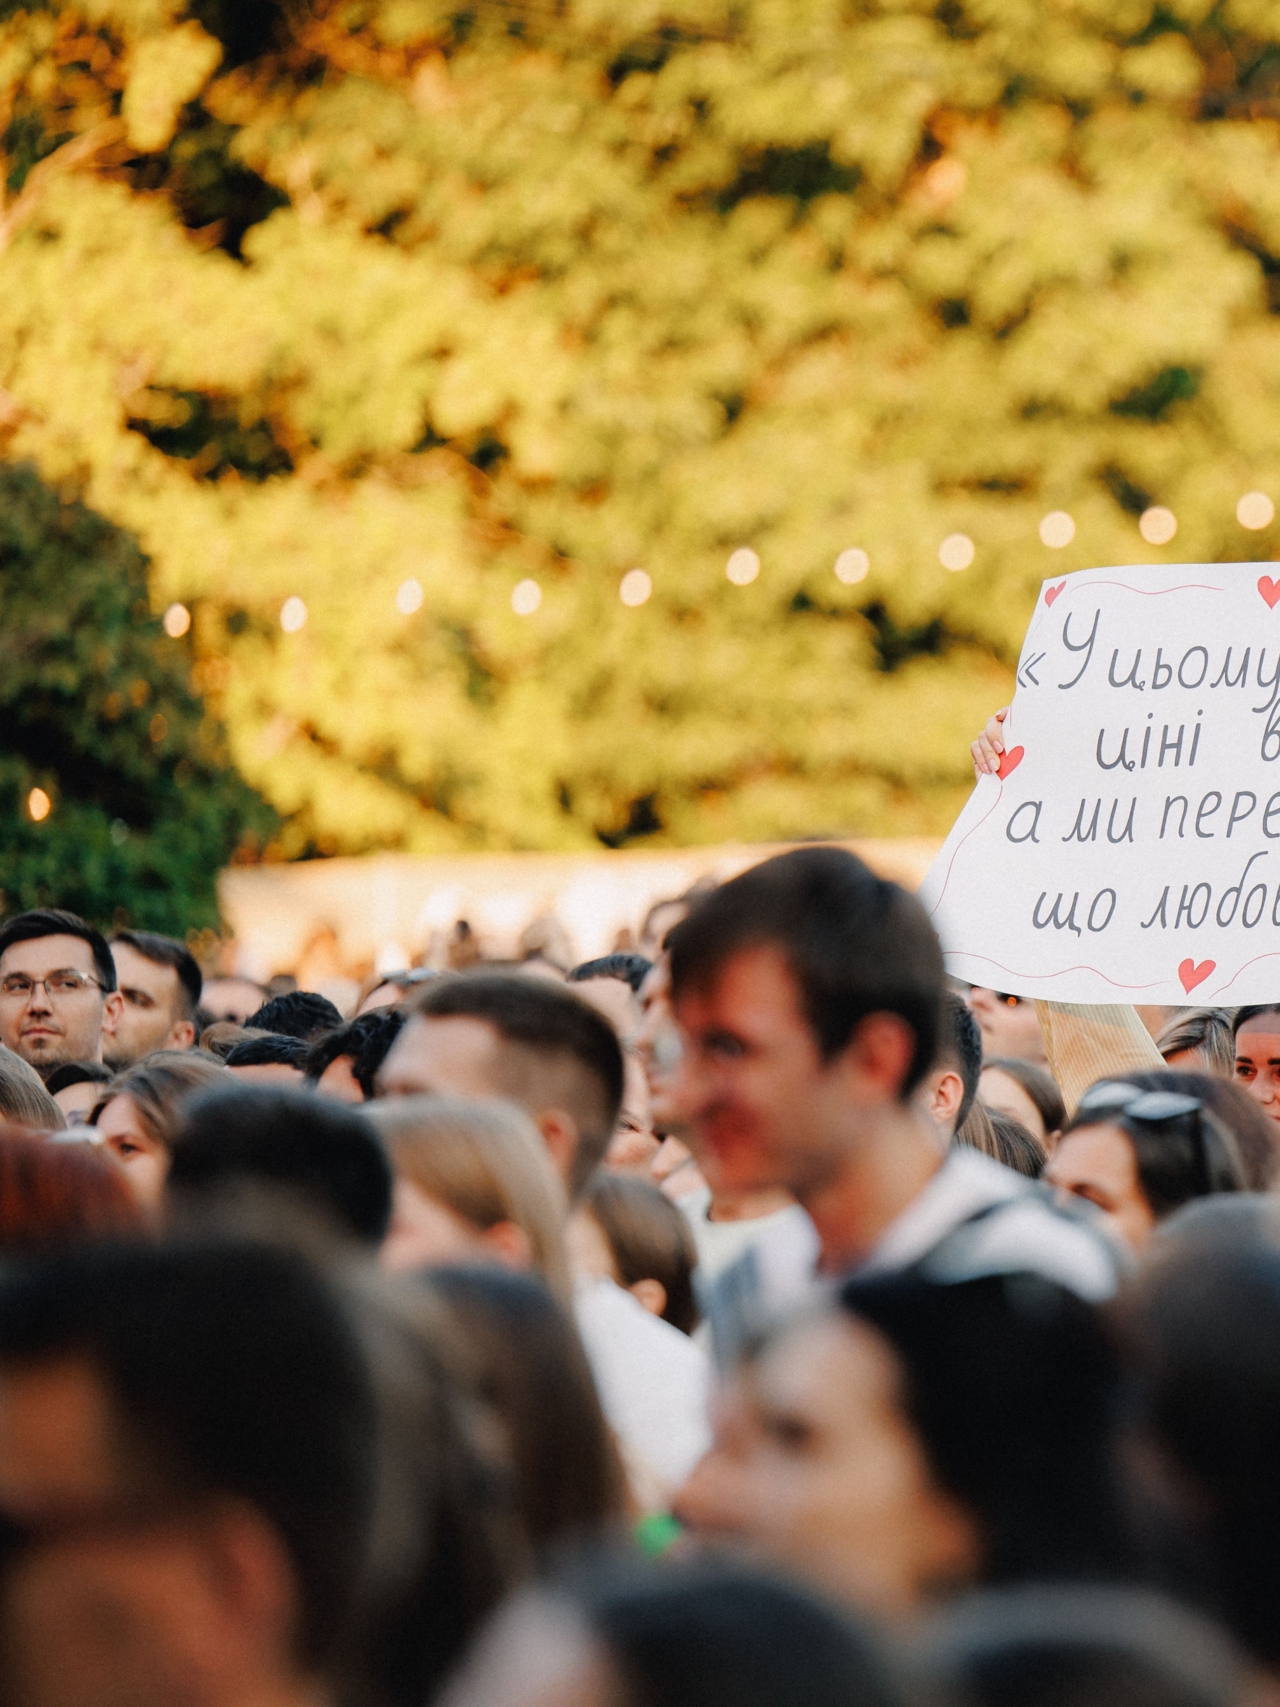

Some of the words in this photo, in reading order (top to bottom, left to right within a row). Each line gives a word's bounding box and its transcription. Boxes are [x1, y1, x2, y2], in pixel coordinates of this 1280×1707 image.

[1095, 710, 1204, 773] ціні
[1005, 800, 1043, 844] а
[1061, 796, 1137, 844] ми
[1032, 887, 1117, 938] що
